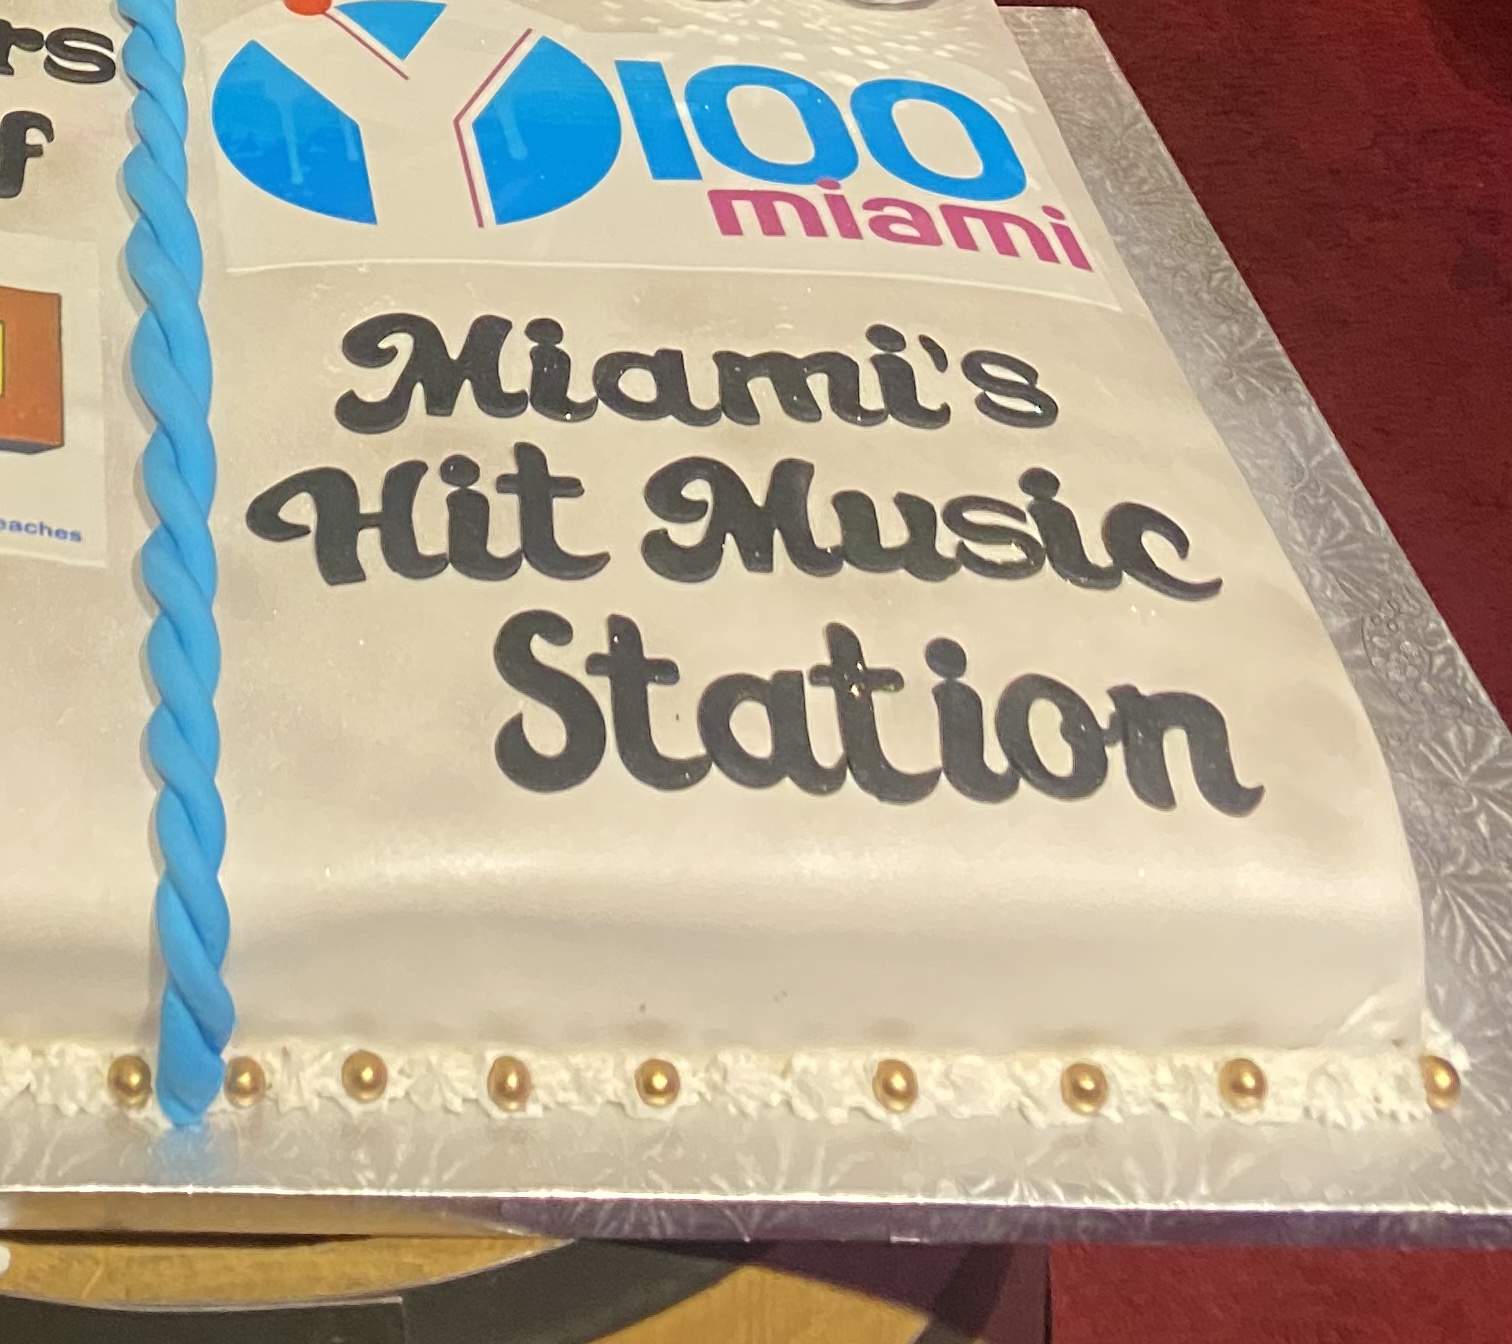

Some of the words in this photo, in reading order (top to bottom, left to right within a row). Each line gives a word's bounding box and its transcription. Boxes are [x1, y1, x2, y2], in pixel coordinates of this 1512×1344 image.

[707, 178, 1095, 273] miami
[334, 313, 1060, 435] Miami's
[245, 440, 611, 586] Hit
[640, 454, 1224, 601] Music
[492, 608, 1265, 817] Station
